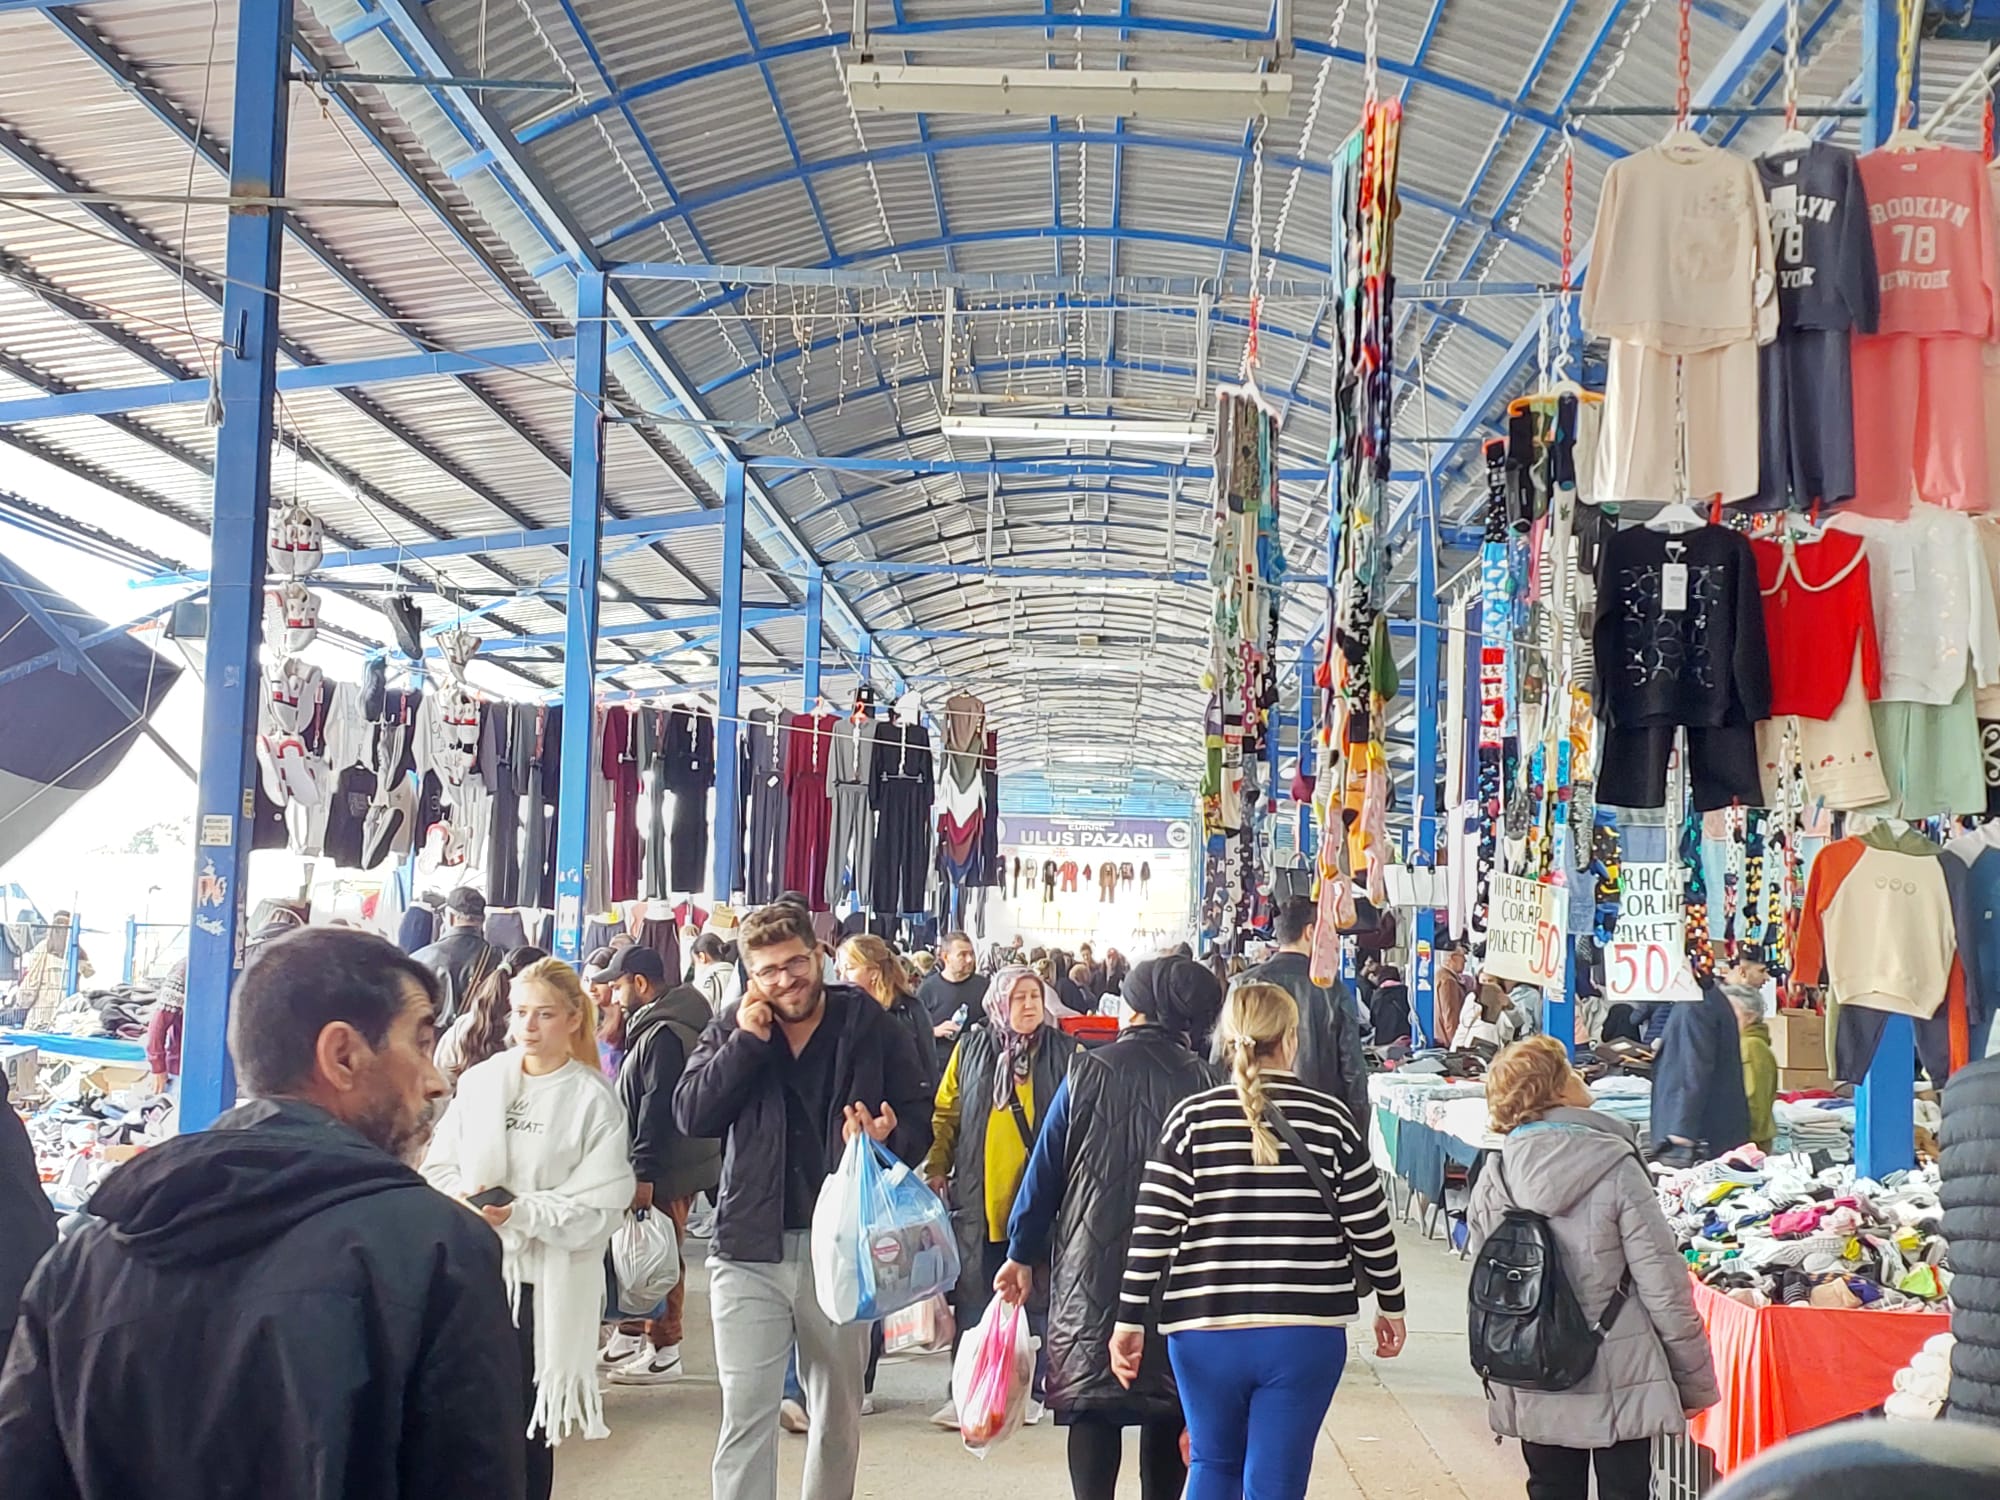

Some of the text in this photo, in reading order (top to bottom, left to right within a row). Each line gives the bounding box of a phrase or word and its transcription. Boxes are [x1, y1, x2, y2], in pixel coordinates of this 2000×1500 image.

[1892, 223, 1936, 264] 78
[1020, 830, 1154, 848] ULUS PAZARI
[1529, 920, 1561, 978] 50
[1611, 943, 1670, 994] 50
